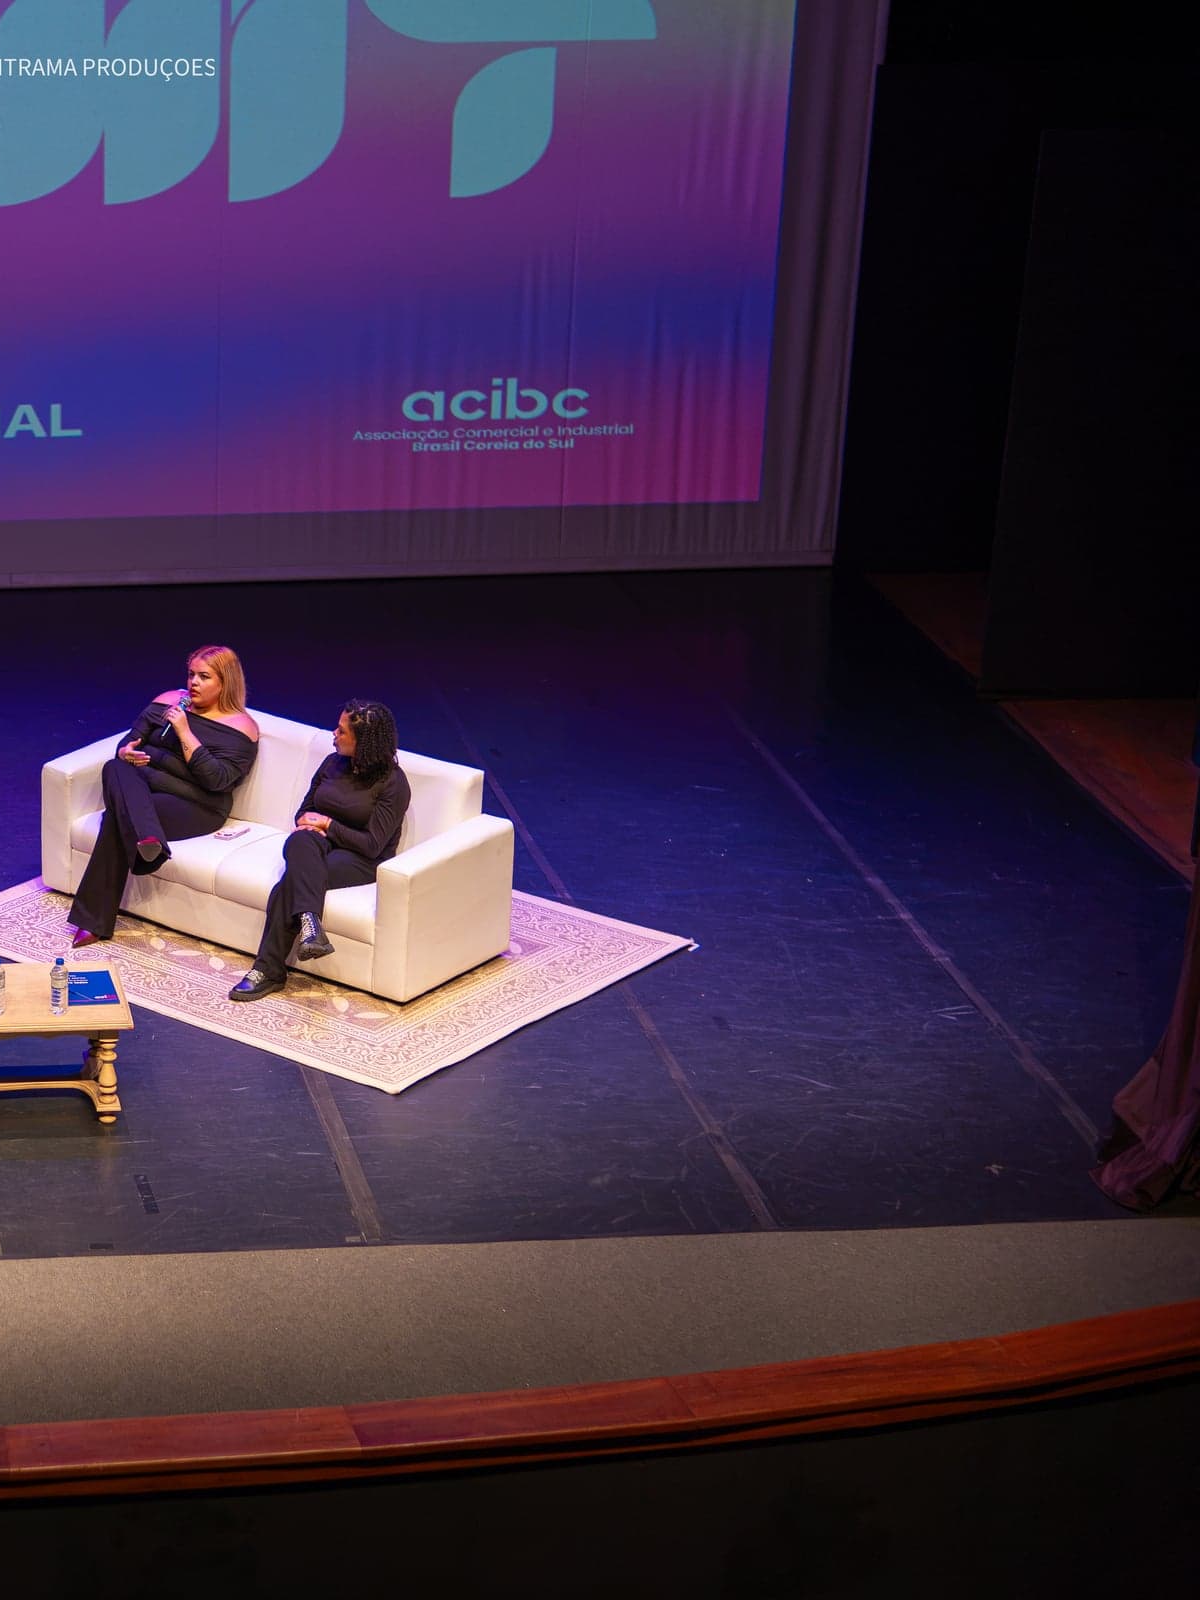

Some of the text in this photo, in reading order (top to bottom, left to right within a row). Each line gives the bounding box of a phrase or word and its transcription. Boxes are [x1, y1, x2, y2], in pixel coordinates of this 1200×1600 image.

[402, 377, 590, 422] acibc
[353, 423, 634, 441] Associação Comercial e Industrial
[412, 438, 574, 452] Brasil Coreia do Sul
